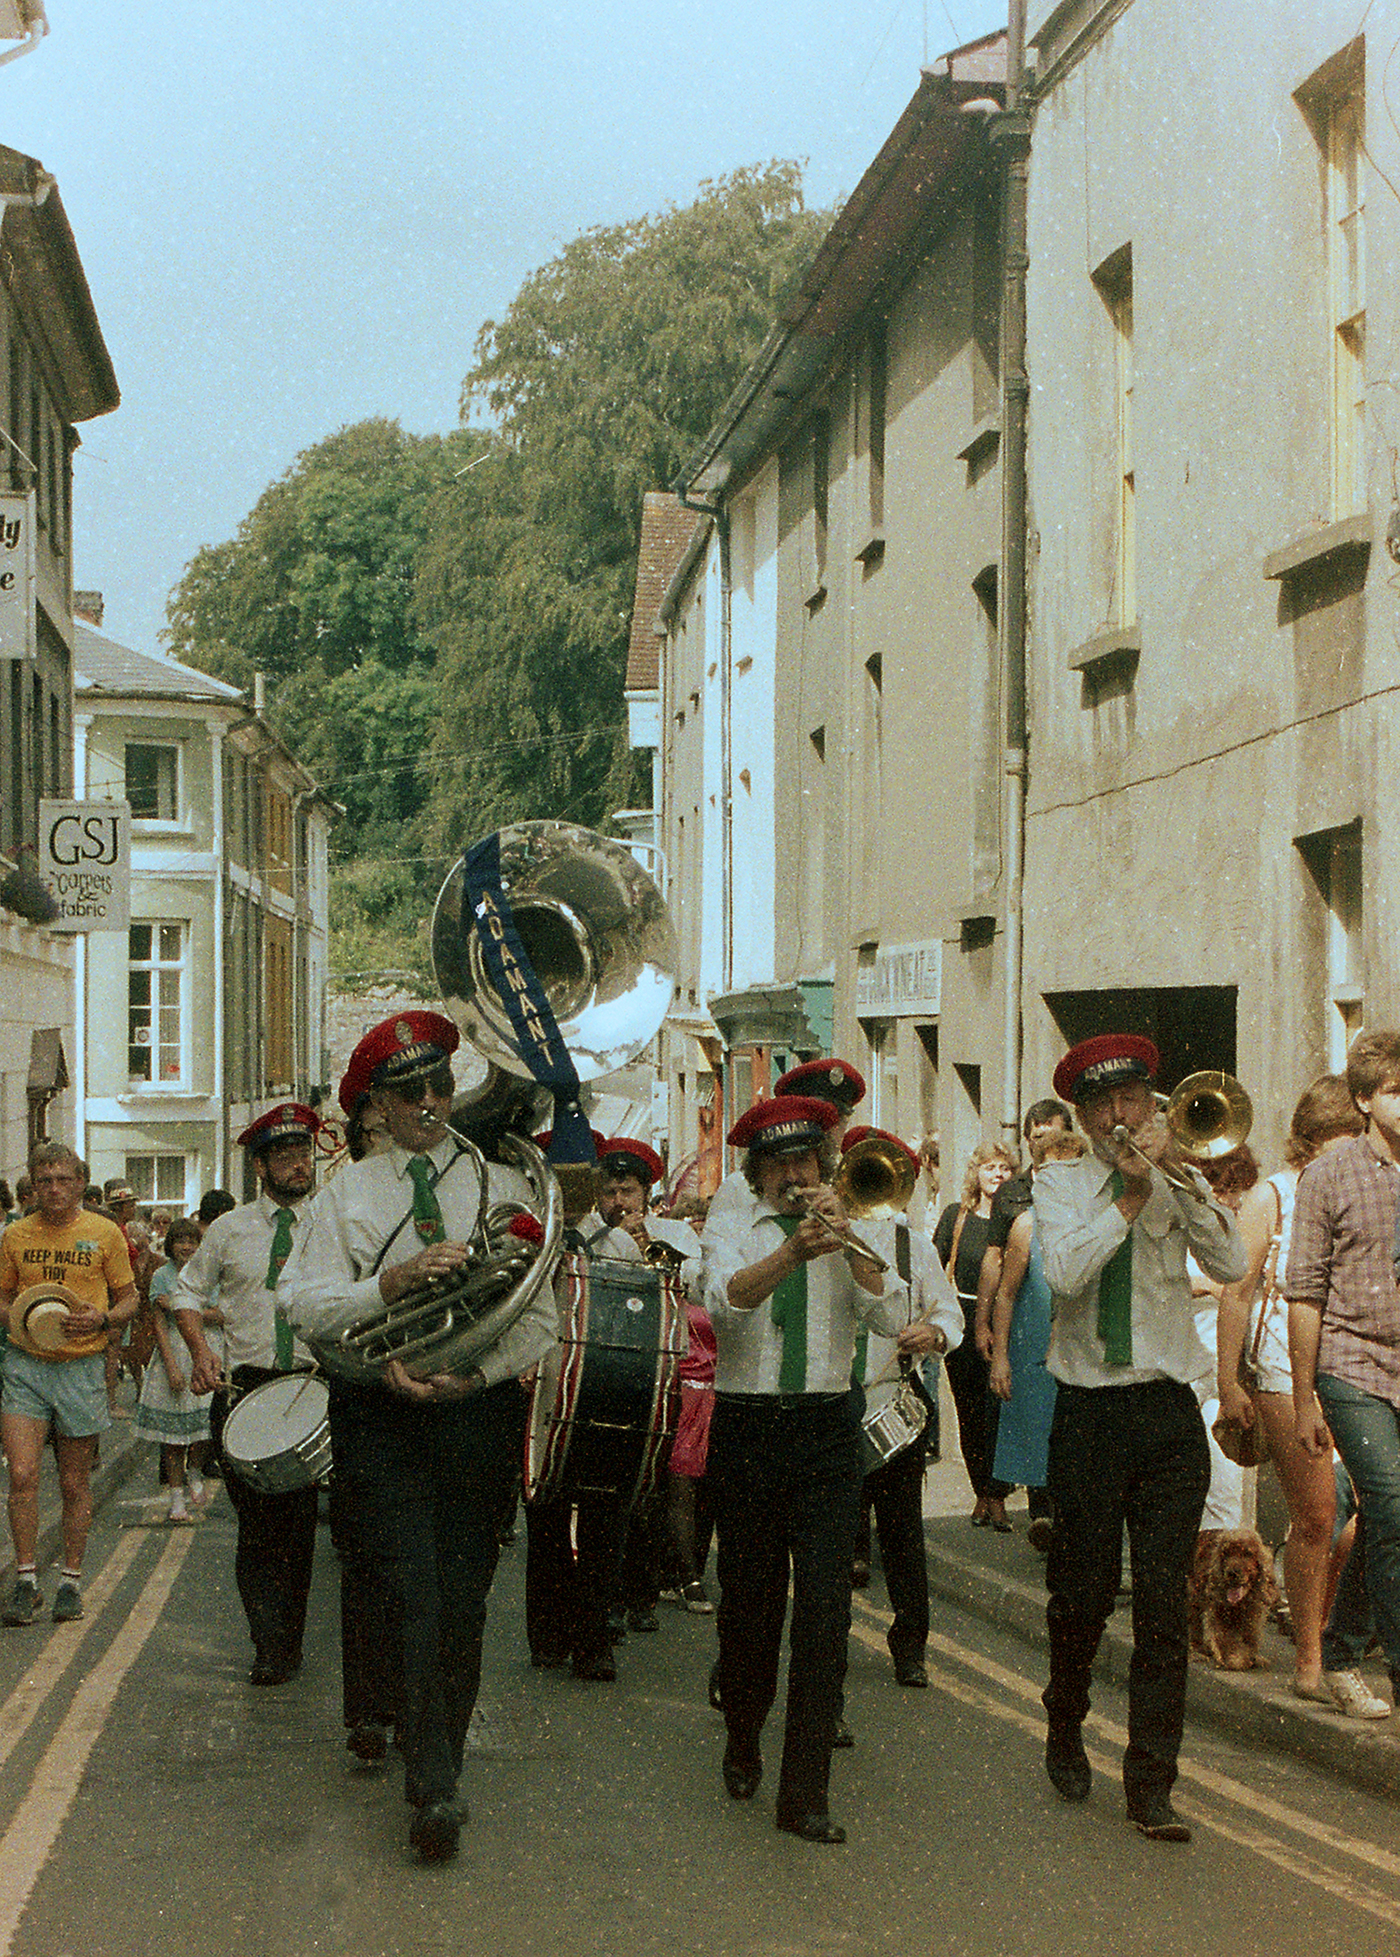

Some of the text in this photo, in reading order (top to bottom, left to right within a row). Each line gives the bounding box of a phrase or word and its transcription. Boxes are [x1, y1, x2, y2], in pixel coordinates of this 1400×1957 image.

[49, 815, 119, 866] GSJ
[482, 891, 554, 1066] ADAMANT
[22, 1249, 92, 1267] KEEP WALES
[42, 1265, 67, 1281] TIDY
